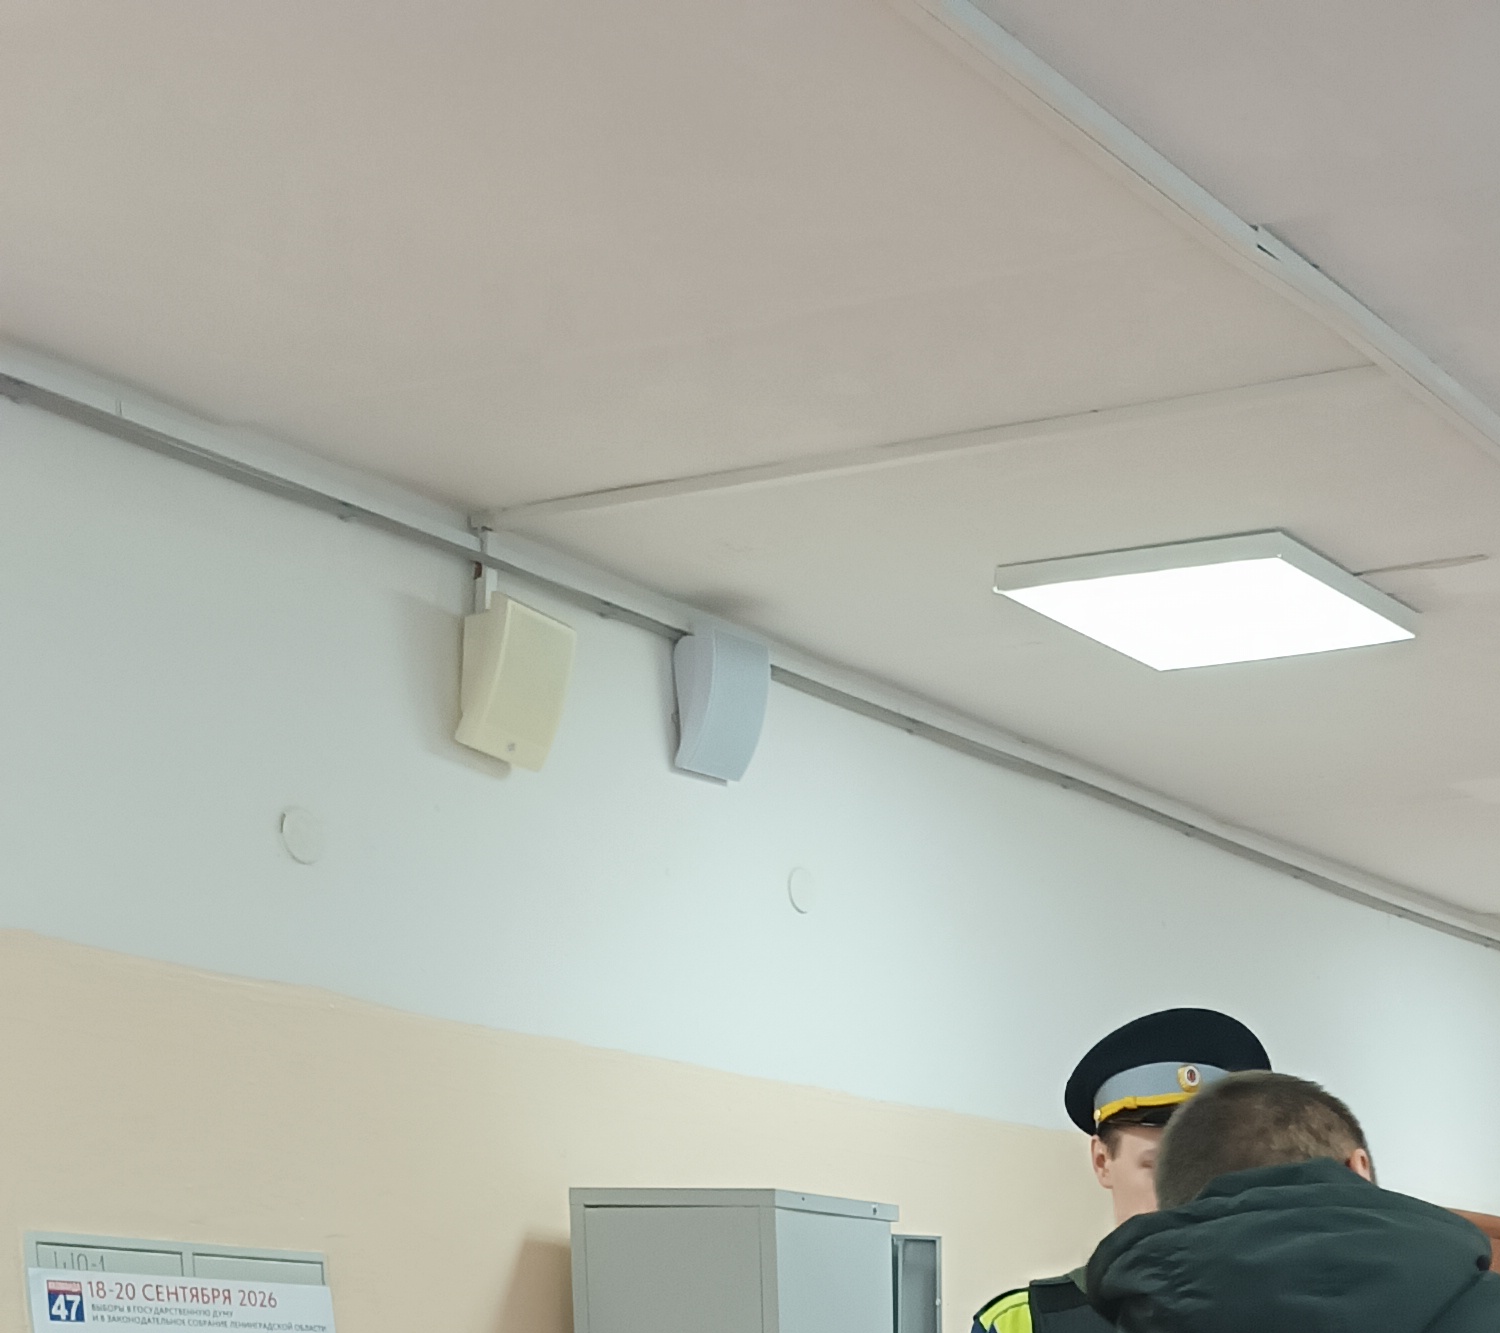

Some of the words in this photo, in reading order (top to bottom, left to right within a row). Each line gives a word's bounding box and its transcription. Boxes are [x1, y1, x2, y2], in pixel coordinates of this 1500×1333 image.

[51, 1294, 81, 1320] 47
[87, 1281, 136, 1300] 18-20
[142, 1284, 232, 1305] СЕНТЯБРЯ
[238, 1289, 277, 1308] 2026
[91, 1303, 125, 1313] ВЫБОРЫ
[133, 1305, 211, 1317] ГОСУДАРСТВЕННУЮ
[212, 1309, 233, 1319] ДУМУ
